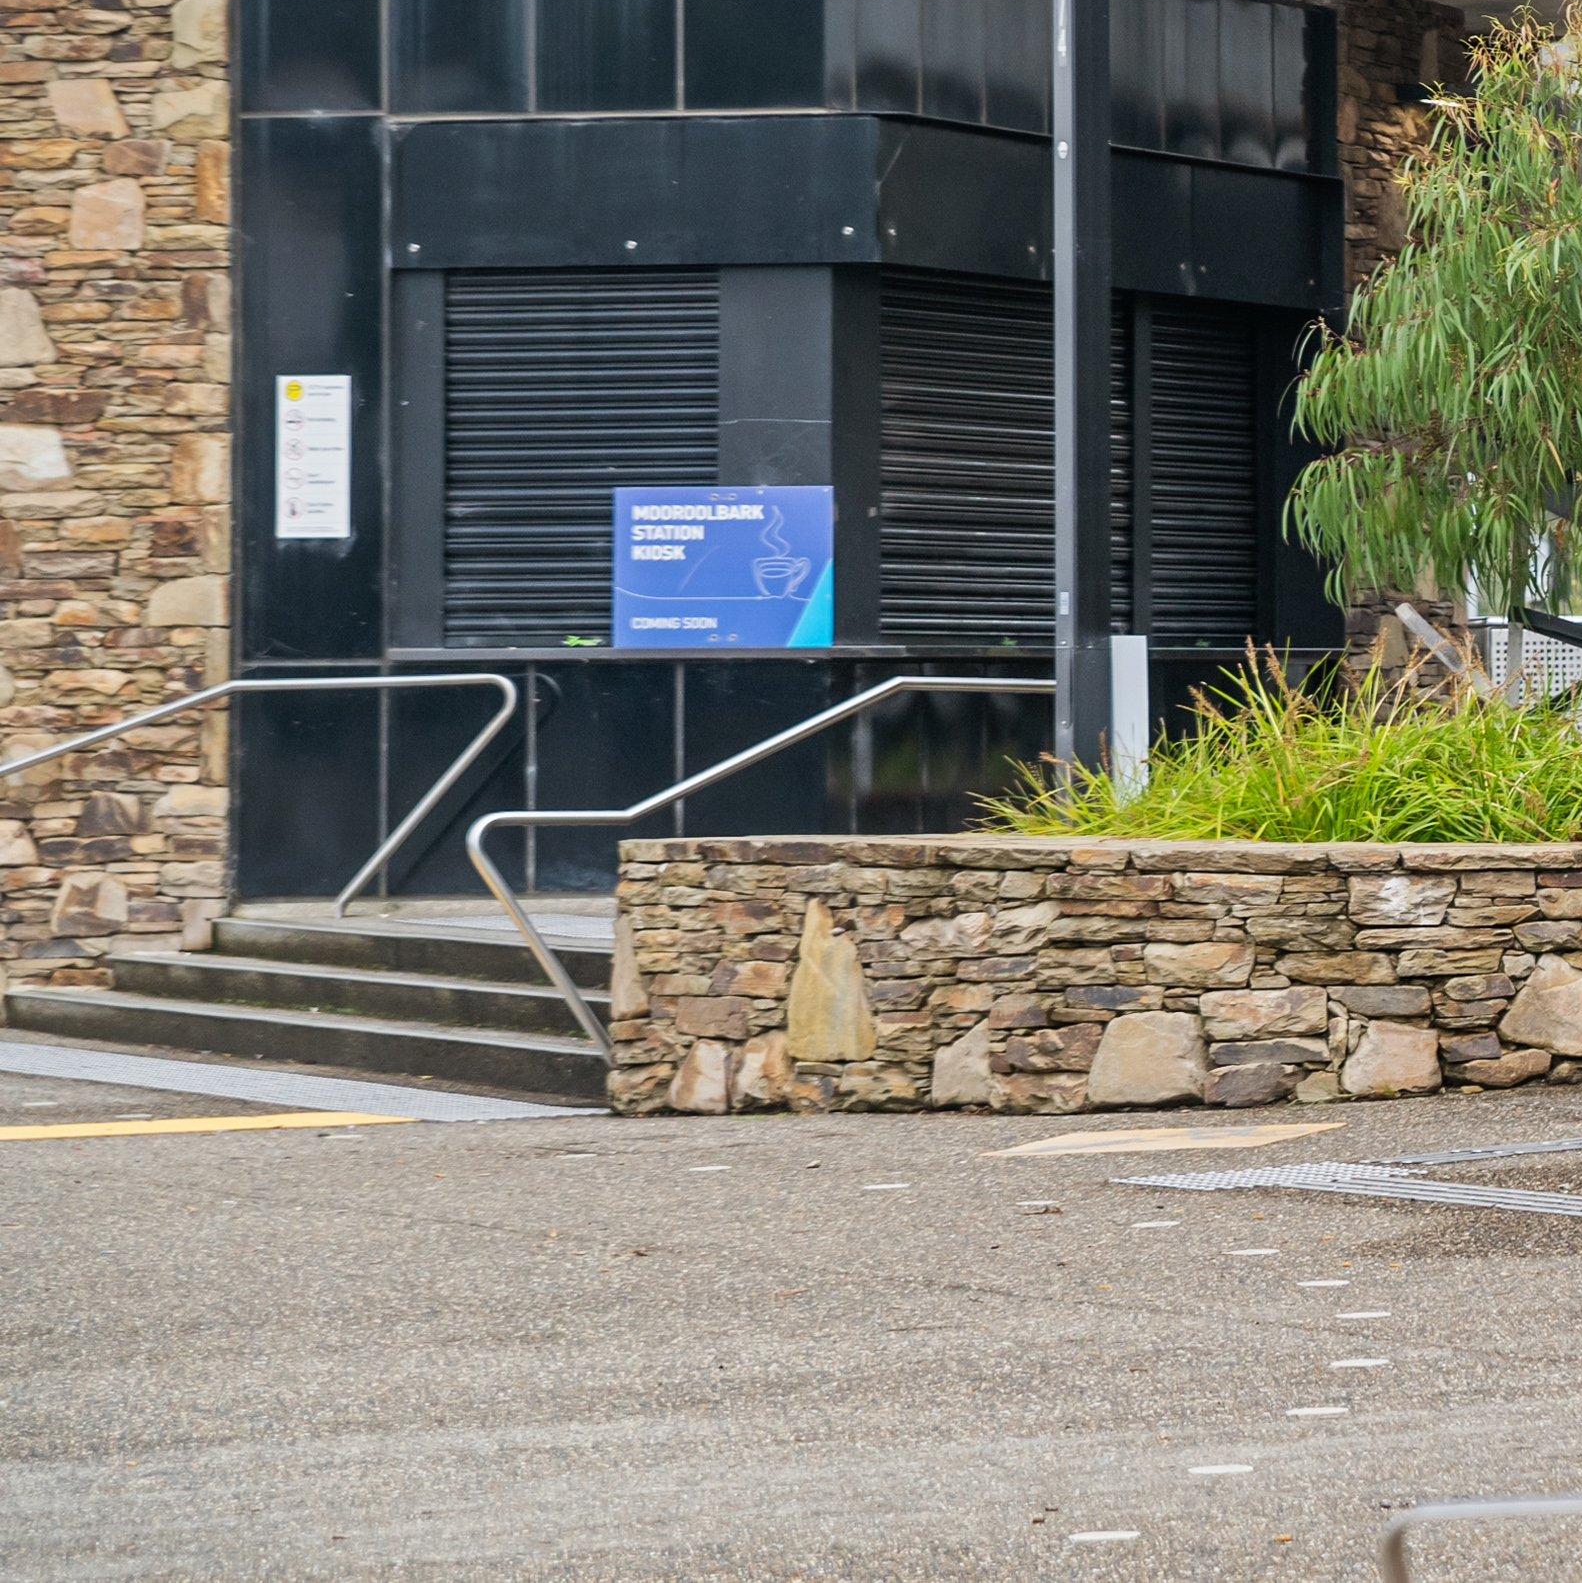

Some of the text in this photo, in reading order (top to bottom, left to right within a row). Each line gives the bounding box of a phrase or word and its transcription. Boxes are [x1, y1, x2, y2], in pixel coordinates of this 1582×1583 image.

[631, 504, 765, 520] MOOROOLBARK
[631, 525, 704, 540] STATION
[631, 545, 686, 560] KIOSK
[630, 617, 718, 629] COMING SOON
